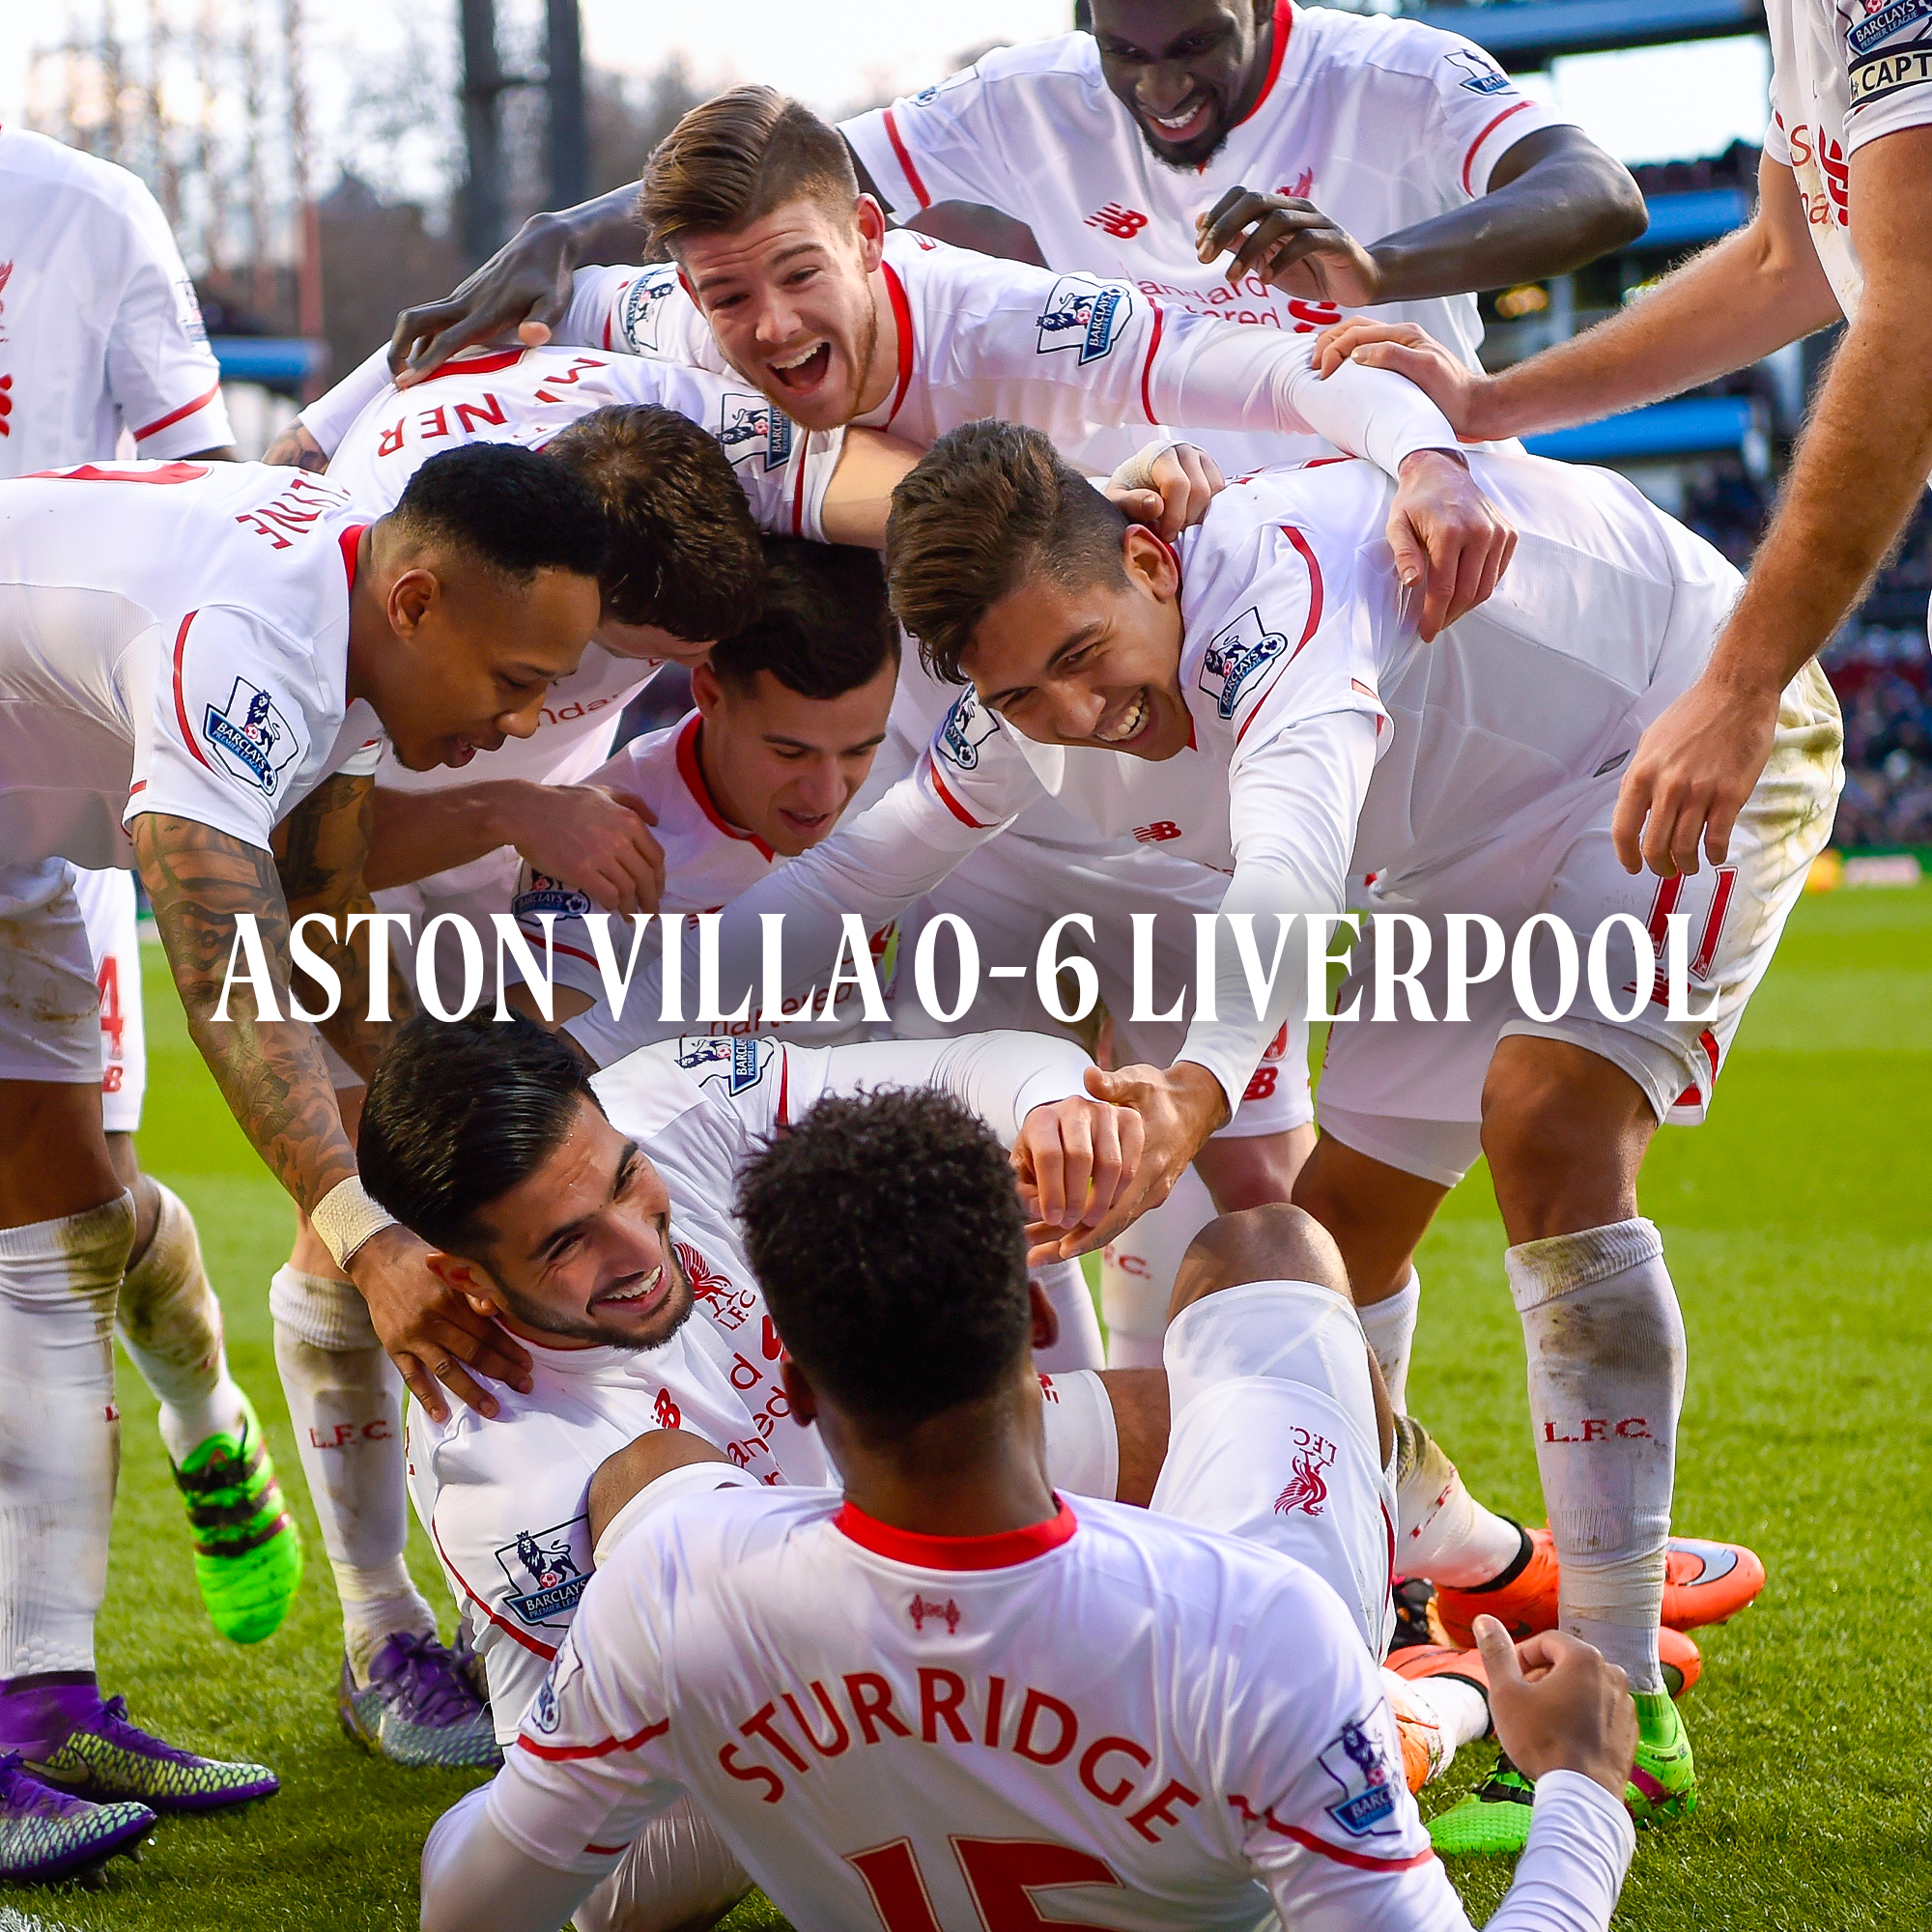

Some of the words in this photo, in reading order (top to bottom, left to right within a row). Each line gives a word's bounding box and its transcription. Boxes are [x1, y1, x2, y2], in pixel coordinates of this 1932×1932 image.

[1856, 0, 1916, 43] BARCLAYS
[1088, 293, 1113, 347] BARCLAYS
[376, 356, 611, 458] MINER
[1222, 650, 1259, 707] BARCLAYS
[216, 722, 267, 770] BARCLAYS
[528, 1603, 562, 1618] PREMIER
[717, 1667, 1201, 1844] STURRIDGE
